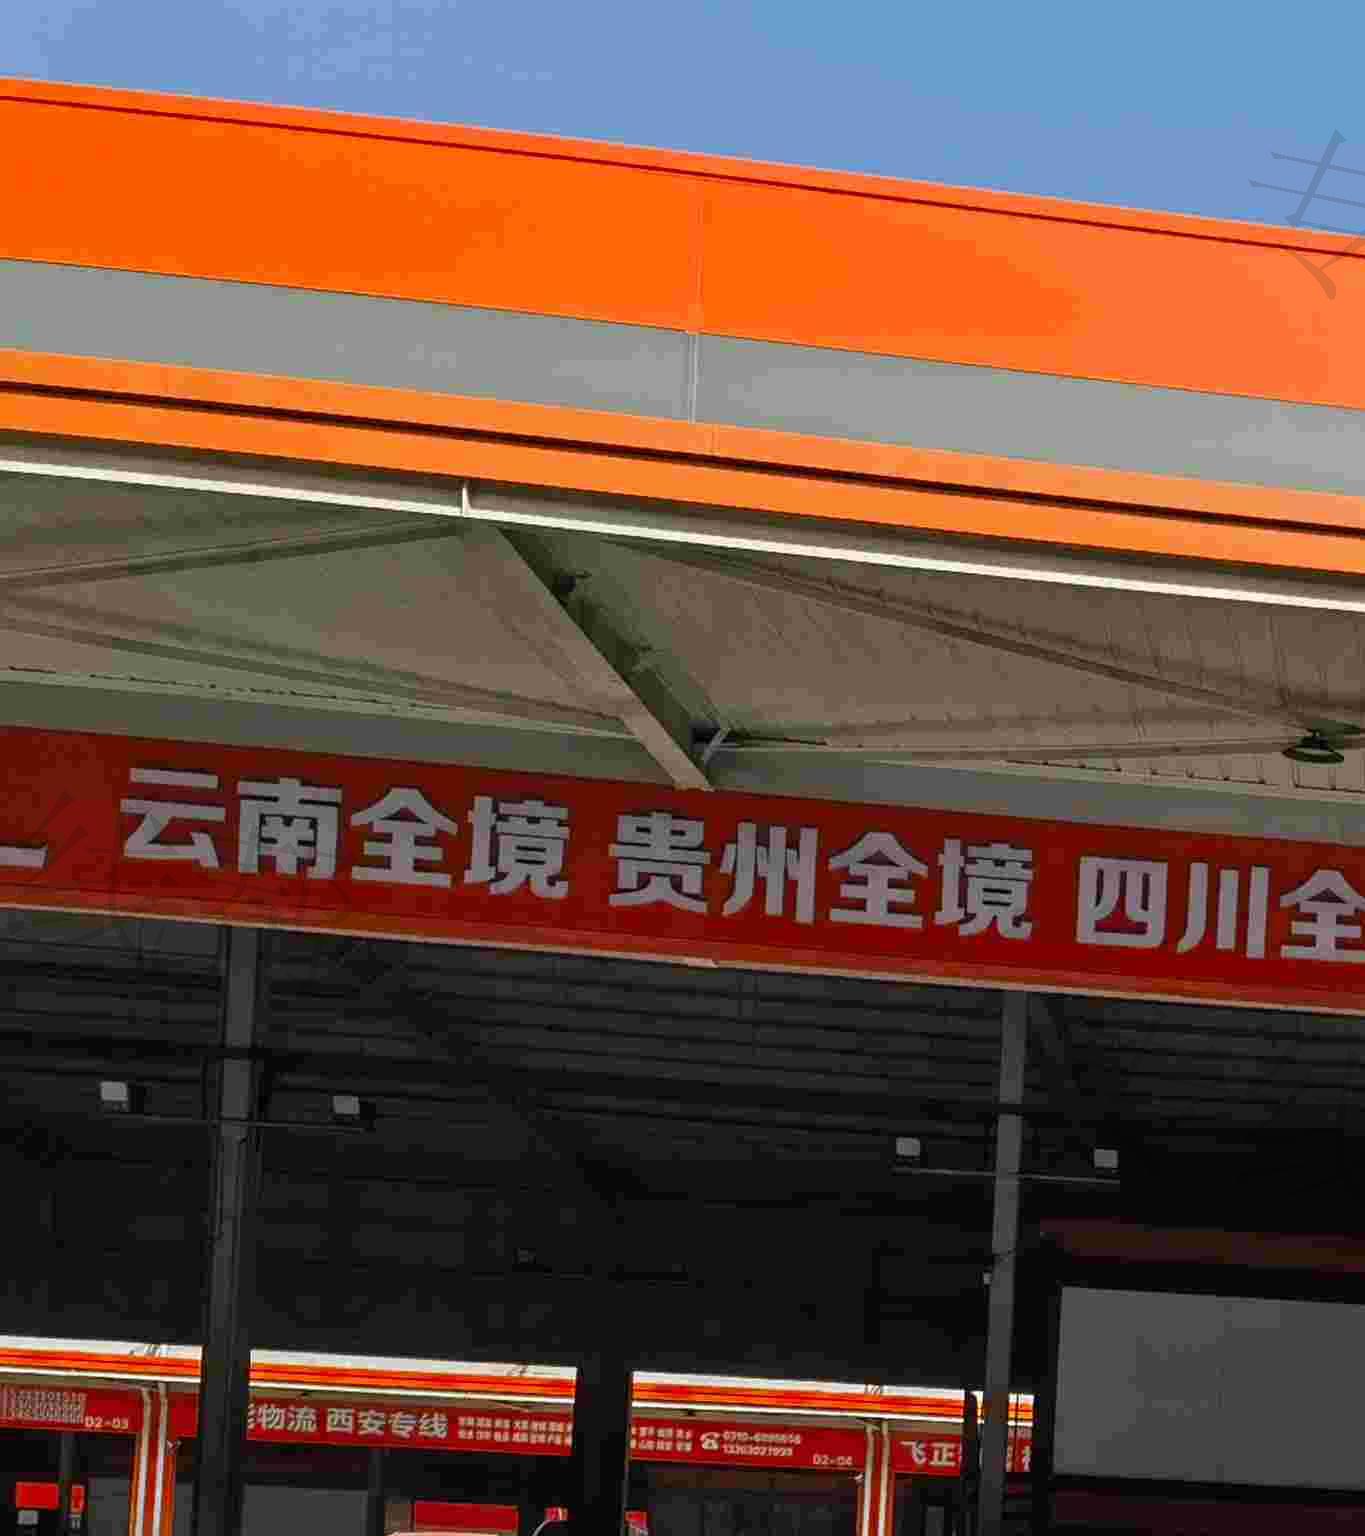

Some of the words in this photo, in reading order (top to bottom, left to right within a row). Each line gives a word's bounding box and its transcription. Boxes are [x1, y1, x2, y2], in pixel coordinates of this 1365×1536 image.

[120, 767, 569, 900] 云南全境
[608, 811, 1035, 941] 贵州全境
[326, 1407, 449, 1439] 西安专线
